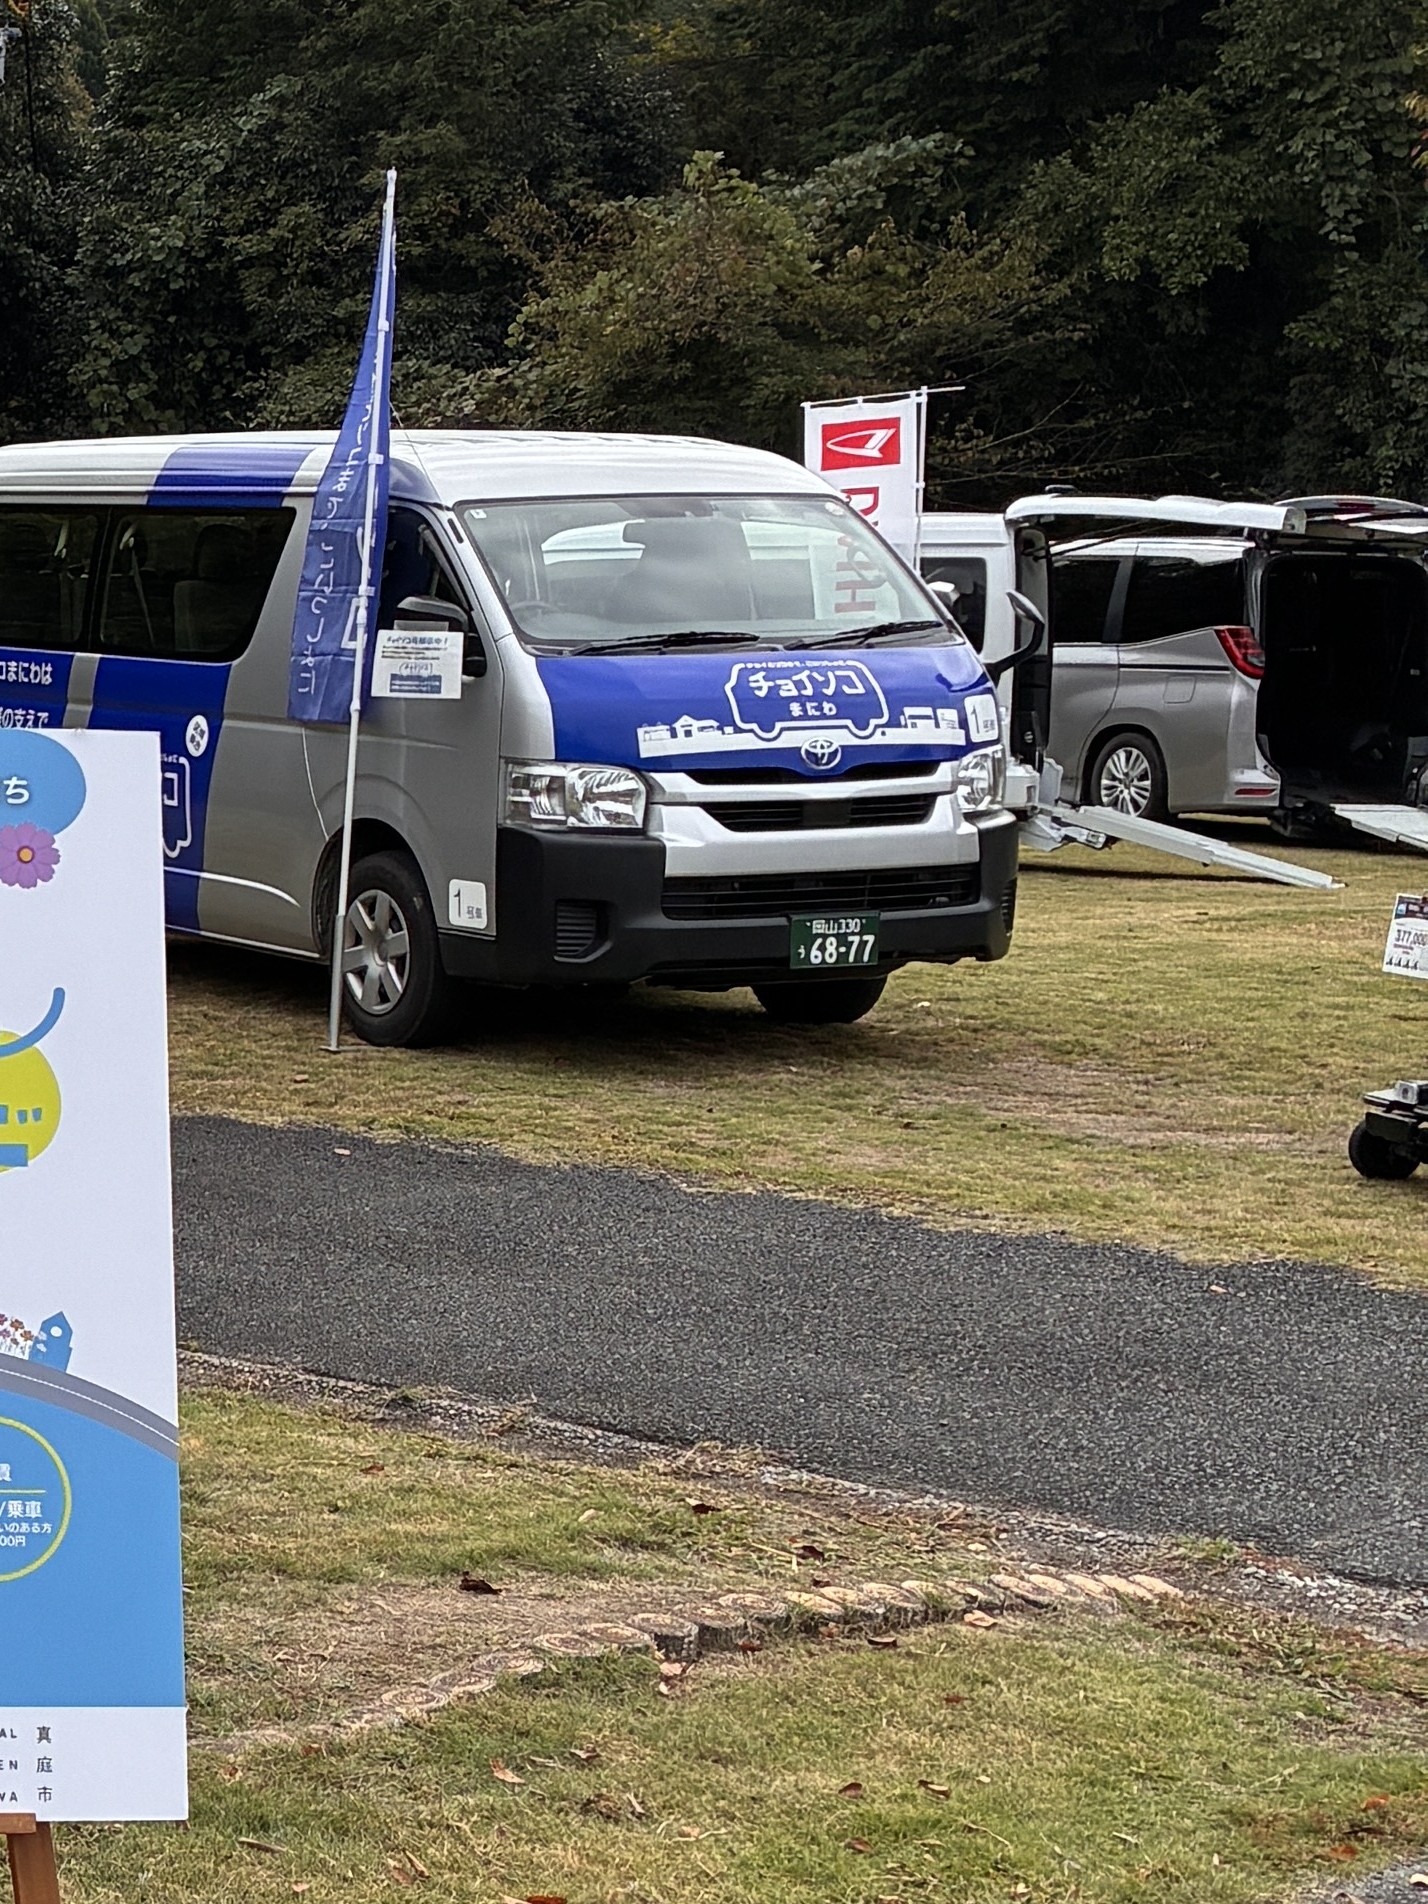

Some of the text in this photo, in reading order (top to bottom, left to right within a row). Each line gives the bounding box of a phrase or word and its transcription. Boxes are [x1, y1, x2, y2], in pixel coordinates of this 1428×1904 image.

[748, 669, 866, 698] チョイソコ
[789, 701, 837, 717] まにわ
[810, 935, 875, 964] 68-77
[36, 1725, 51, 1744] 真
[36, 1756, 52, 1773] 庭
[37, 1786, 52, 1802] 市
